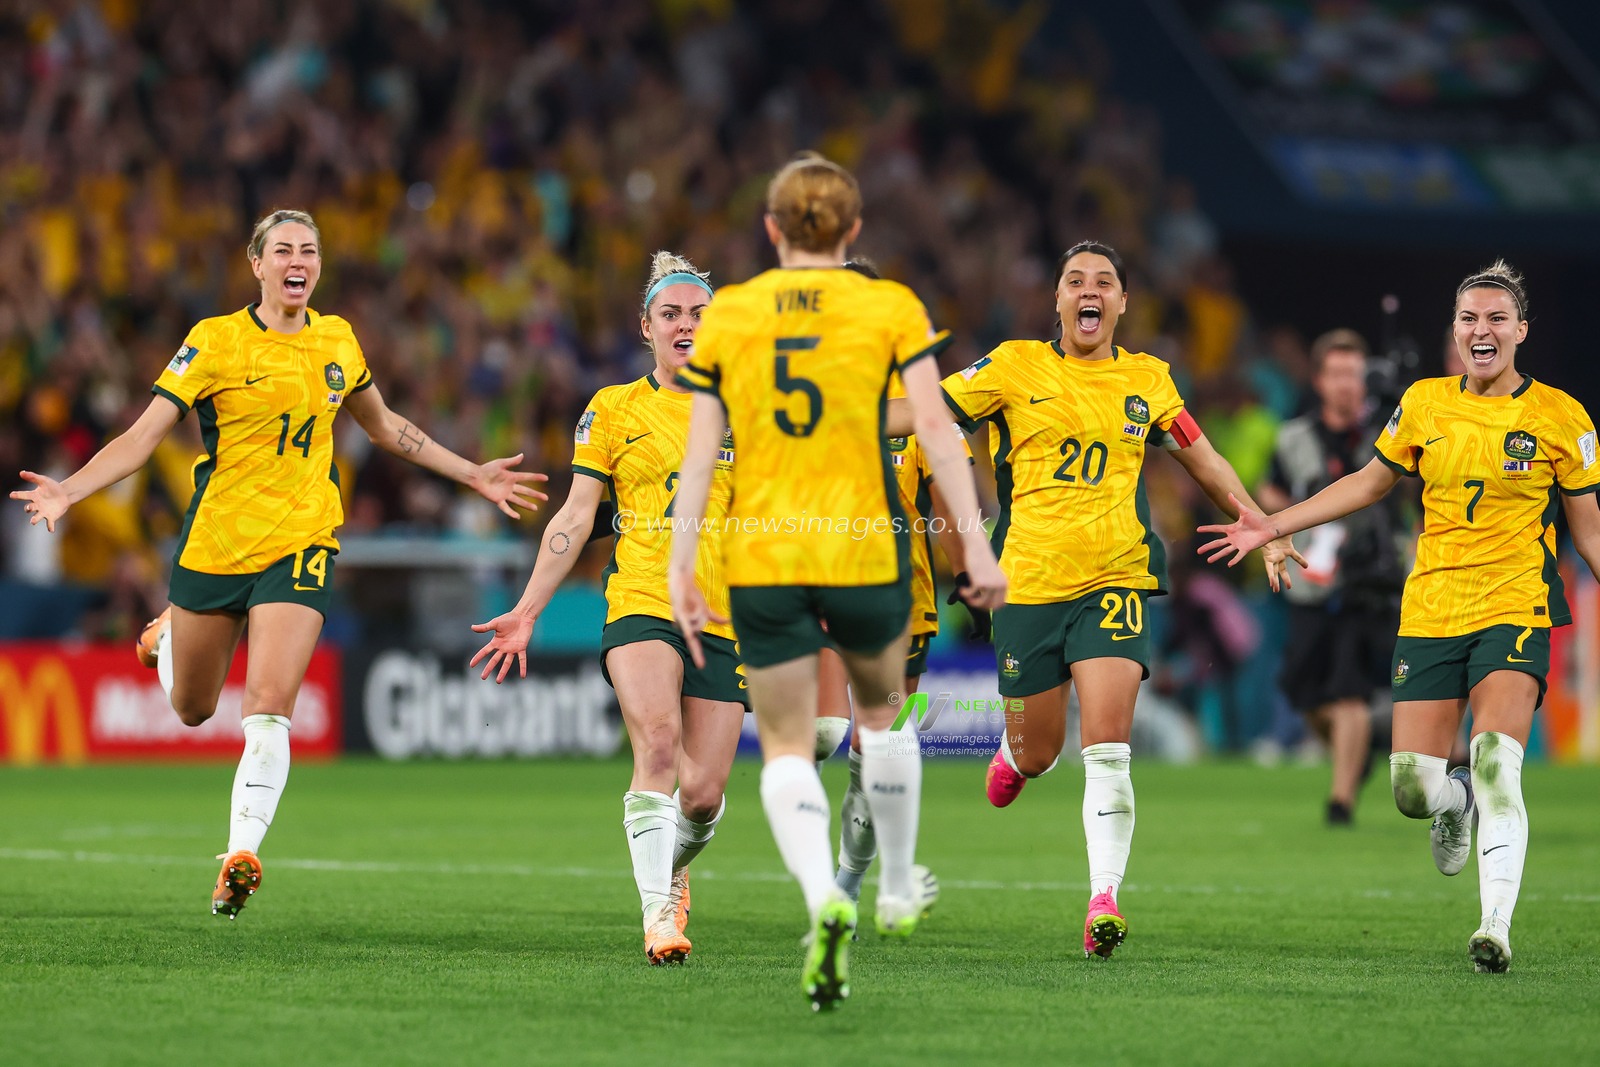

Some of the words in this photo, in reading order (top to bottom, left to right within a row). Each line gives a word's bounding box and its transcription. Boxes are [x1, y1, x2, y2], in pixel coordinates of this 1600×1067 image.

[775, 289, 822, 313] VINE
[774, 336, 823, 438] 5
[277, 413, 318, 458] 14
[1053, 438, 1108, 486] 20
[1463, 479, 1485, 524] 7
[292, 549, 328, 587] 14
[1099, 591, 1143, 634] 20
